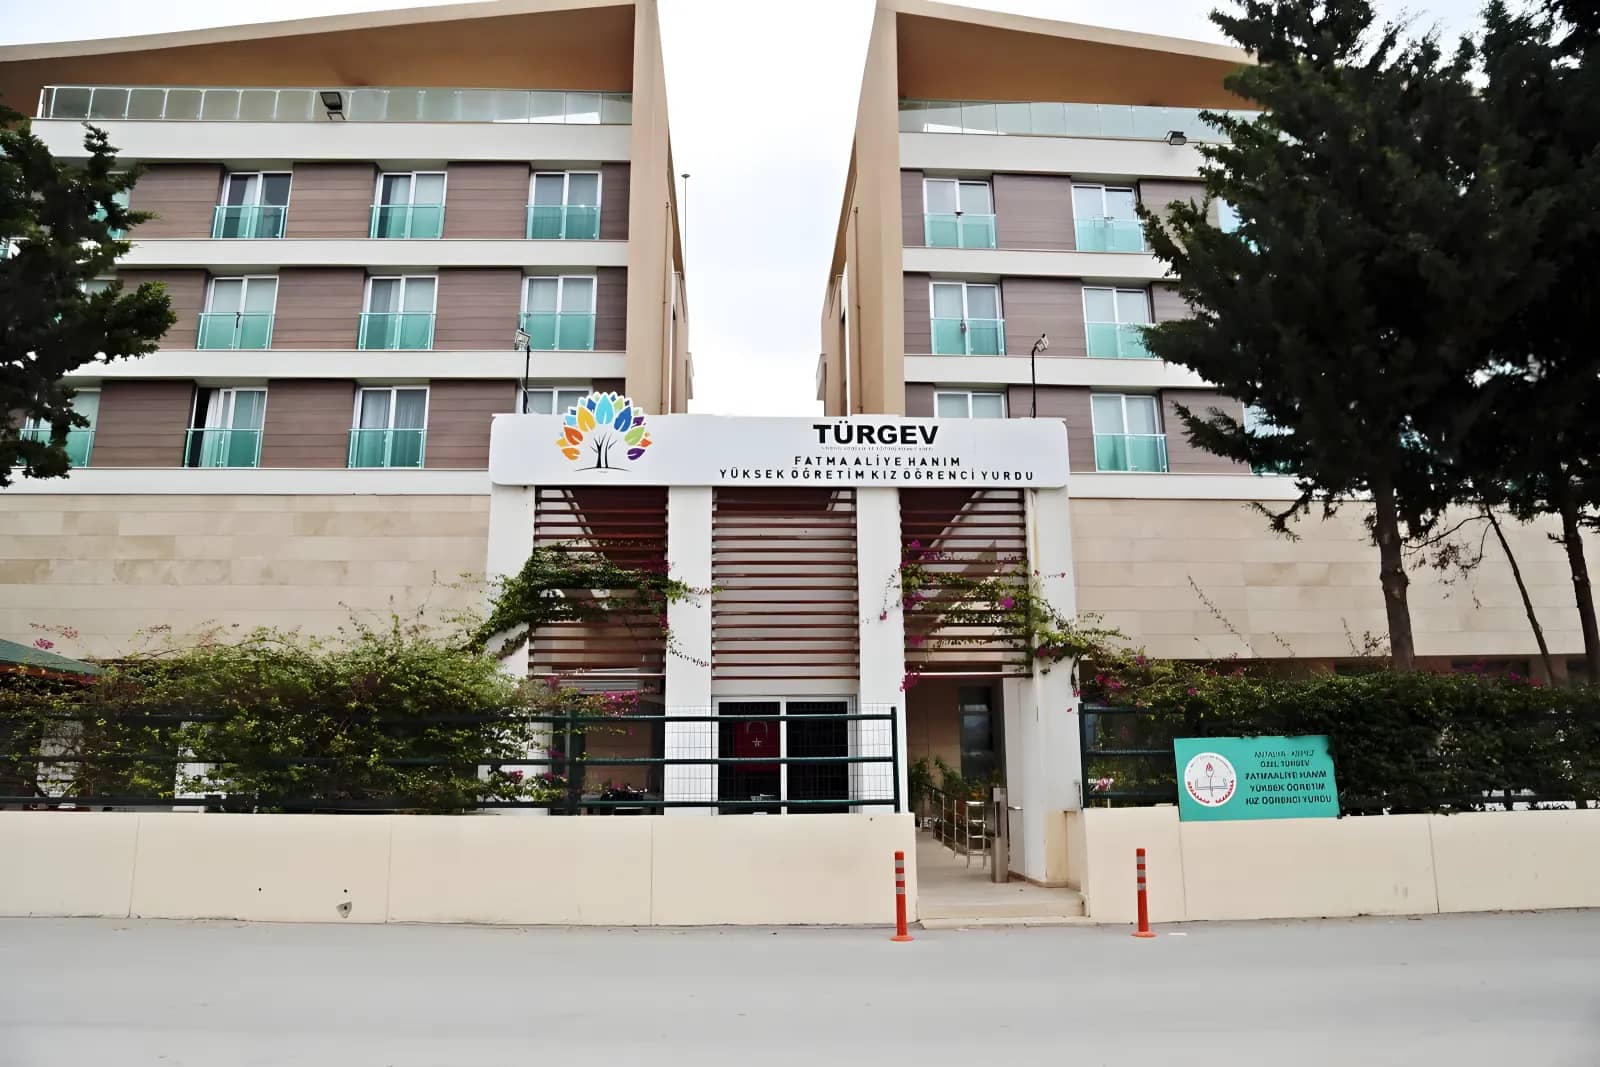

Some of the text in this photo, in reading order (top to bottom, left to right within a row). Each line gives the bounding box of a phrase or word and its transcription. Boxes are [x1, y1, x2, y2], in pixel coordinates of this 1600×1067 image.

[813, 420, 939, 445] TÜRGEV
[794, 454, 960, 467] FATMA ALİYE HANIM
[719, 467, 785, 480] YÜKSEK
[871, 470, 897, 480] KIZ
[981, 470, 1034, 481] YURDU
